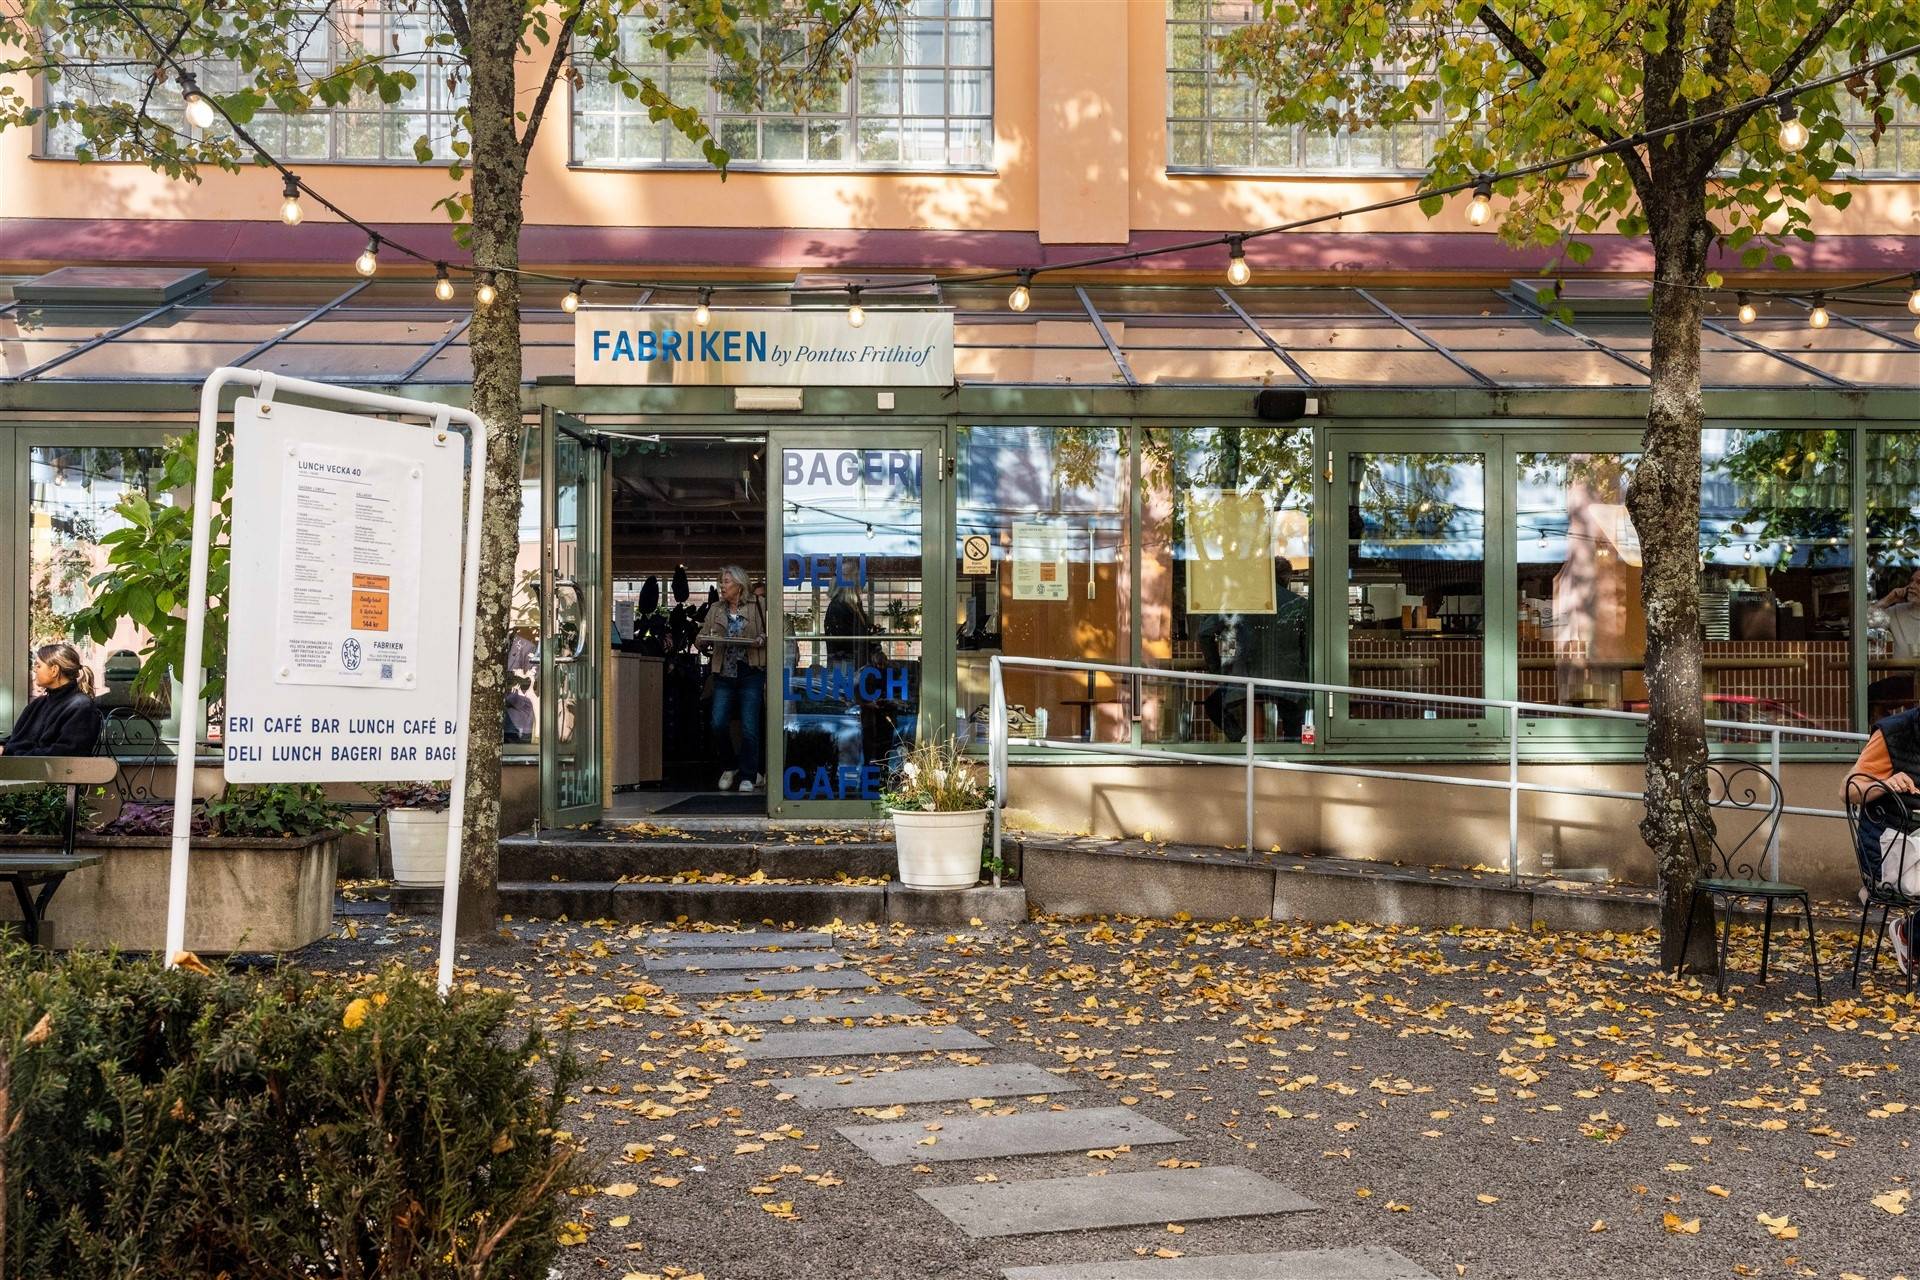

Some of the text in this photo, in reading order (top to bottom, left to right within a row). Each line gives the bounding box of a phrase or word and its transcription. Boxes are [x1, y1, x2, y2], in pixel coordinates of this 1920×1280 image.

[592, 330, 936, 367] FABRIKEN by Pontus Frithiof
[298, 460, 325, 472] LUNCH
[326, 464, 351, 475] VECKA
[351, 468, 362, 477] 40
[783, 452, 922, 486] BAGERI
[783, 553, 868, 590] DELI
[373, 641, 404, 650] FABRIKEN
[783, 665, 909, 702] LUNCH
[229, 716, 254, 733] ERI
[264, 714, 302, 733] CAFÉ
[311, 718, 340, 733] BAR
[349, 719, 395, 734] LUNCH
[403, 717, 436, 735] CAFÉ
[228, 746, 262, 761] DELI
[272, 746, 322, 761] LUNCH
[331, 746, 382, 761] BAGERI
[390, 746, 417, 761] BAR
